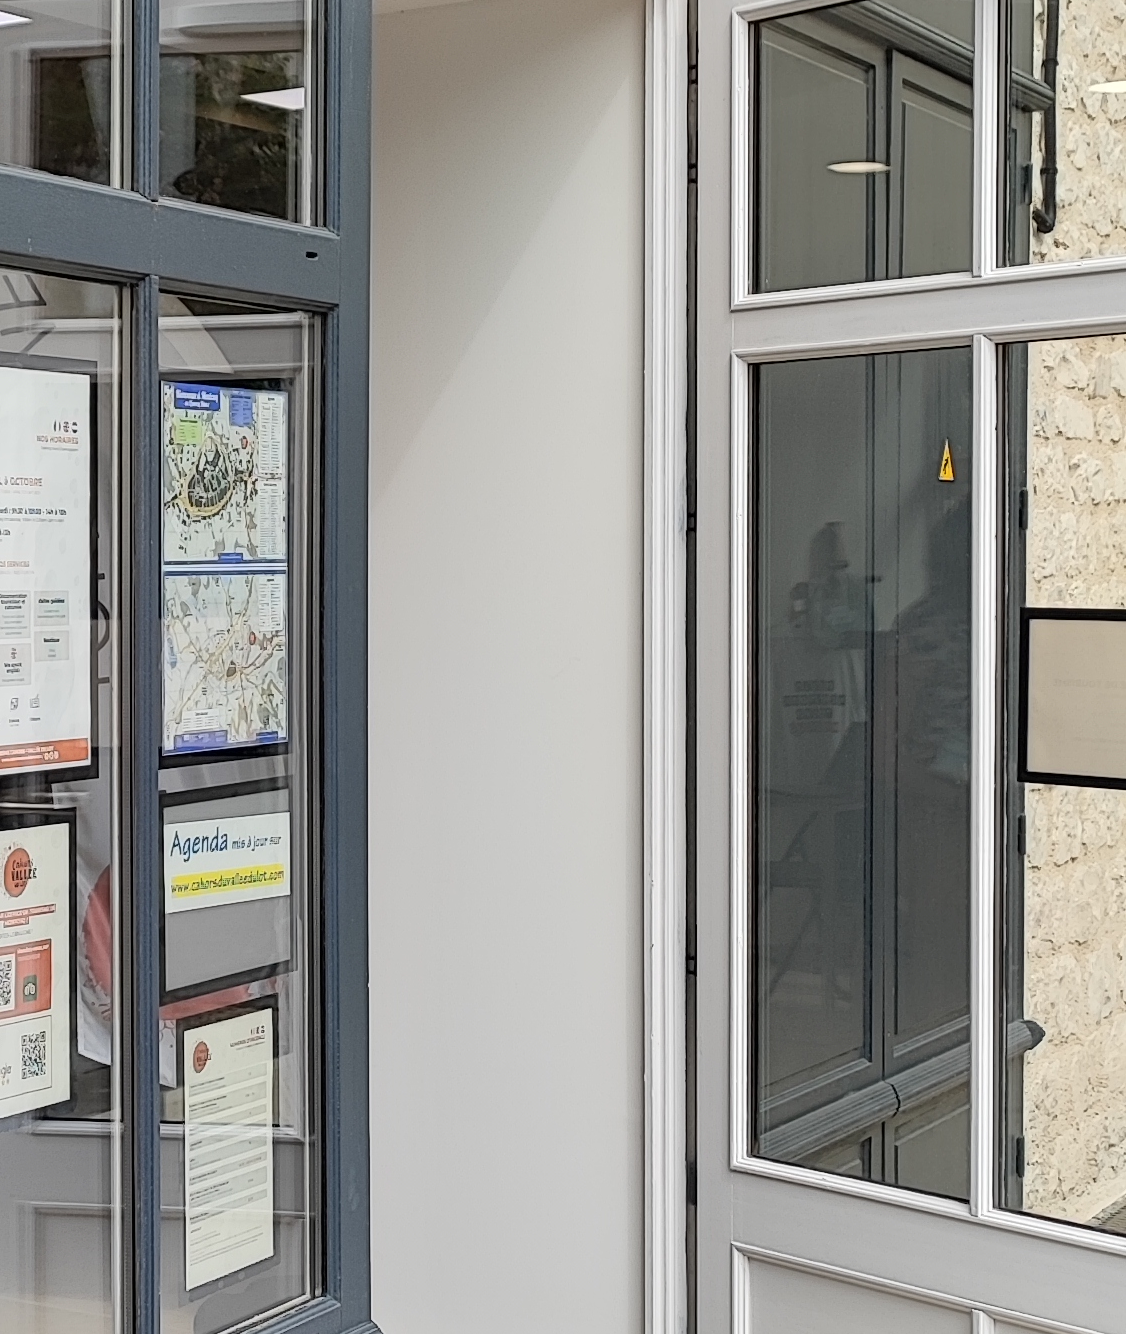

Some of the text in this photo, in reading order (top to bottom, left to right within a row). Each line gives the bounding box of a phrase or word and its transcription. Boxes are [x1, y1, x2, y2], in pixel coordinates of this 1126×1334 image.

[10, 477, 43, 487] OCTOBRE
[170, 827, 228, 862] Agenda
[231, 836, 245, 850] mis
[251, 836, 268, 852] jour
